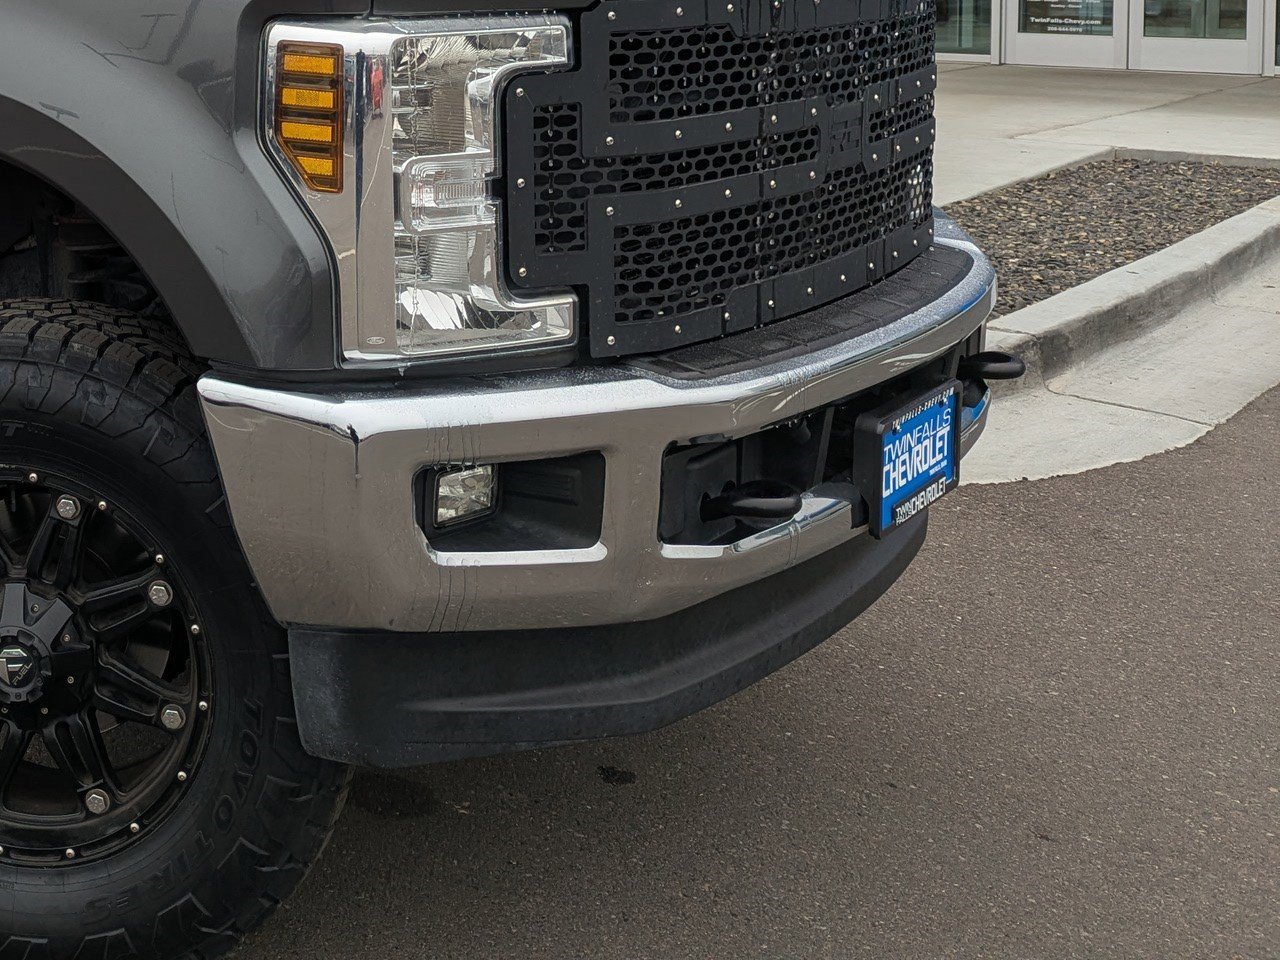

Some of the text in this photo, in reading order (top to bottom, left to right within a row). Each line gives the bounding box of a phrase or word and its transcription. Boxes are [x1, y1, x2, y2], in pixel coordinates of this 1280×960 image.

[882, 425, 951, 499] CHEVROLET
[884, 407, 952, 464] TWINFALLS
[911, 476, 947, 514] CHEVROLET
